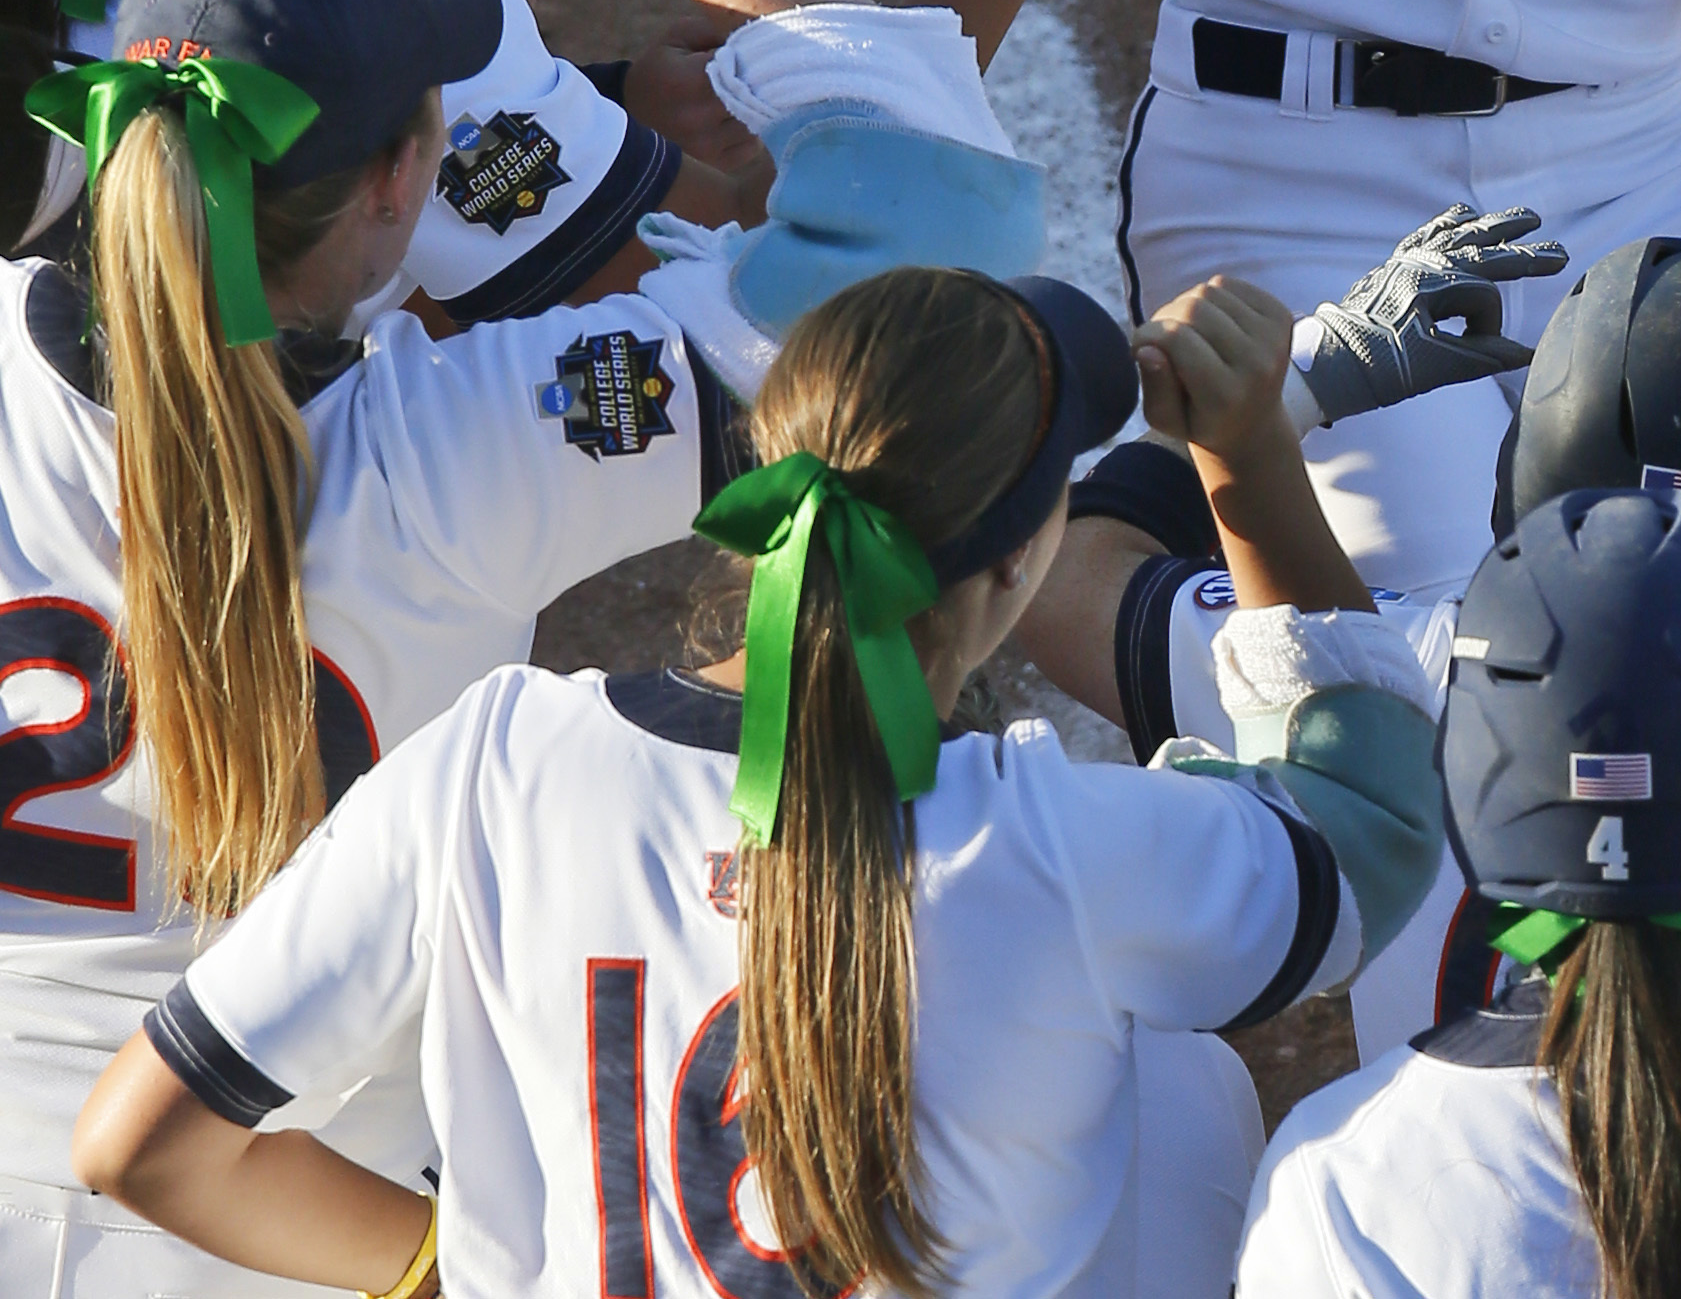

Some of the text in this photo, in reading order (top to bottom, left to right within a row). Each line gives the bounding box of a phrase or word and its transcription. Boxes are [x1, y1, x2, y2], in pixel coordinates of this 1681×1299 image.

[125, 37, 171, 63] WAR
[458, 128, 480, 149] NCAA
[461, 137, 552, 217] WORLD SERIES
[469, 142, 525, 193] COLLEGE
[609, 335, 632, 389] SERIES
[594, 360, 617, 427] COLLEGE
[617, 393, 639, 450] WORLD
[1586, 816, 1629, 881] 4
